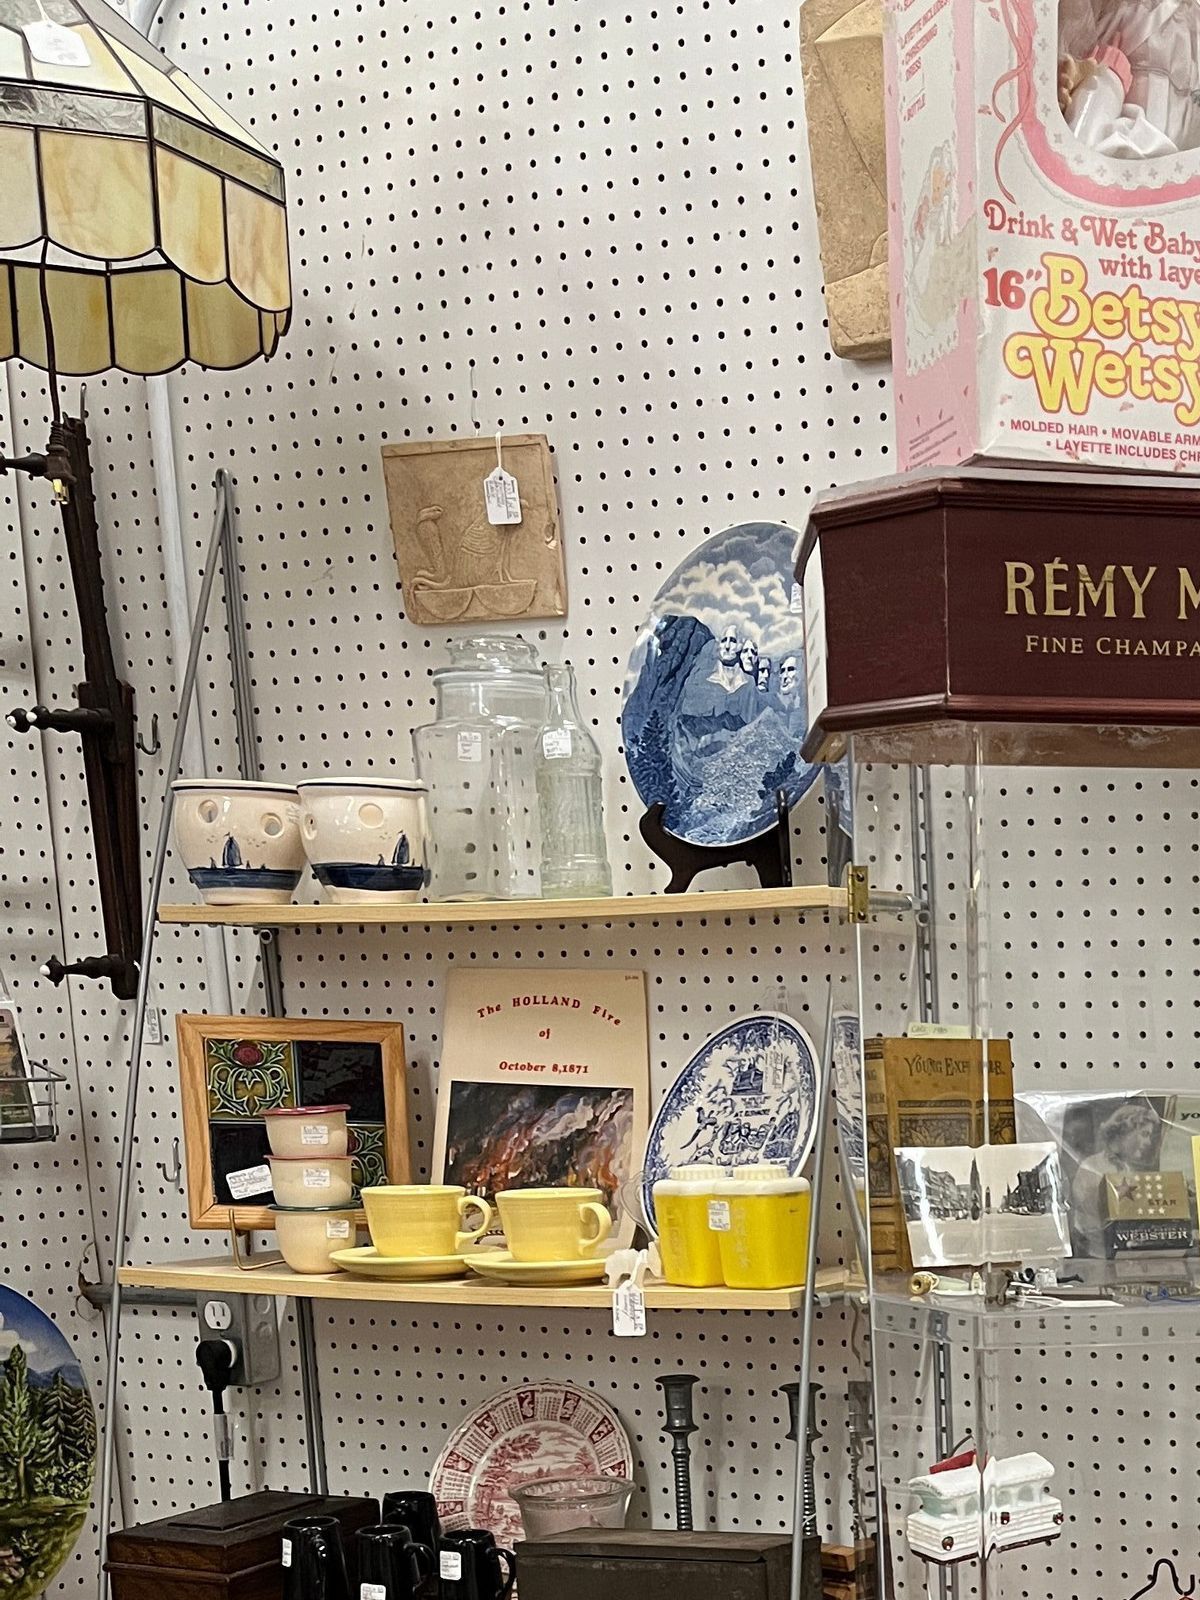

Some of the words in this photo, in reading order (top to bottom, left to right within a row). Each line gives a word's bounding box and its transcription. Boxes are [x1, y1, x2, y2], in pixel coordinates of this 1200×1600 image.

[983, 198, 1056, 240] Drink
[1060, 217, 1079, 246] &
[1079, 214, 1138, 250] Wet
[1098, 253, 1153, 281] with
[1009, 418, 1065, 434] MOLDED
[1067, 422, 1099, 437] HAIR
[1111, 427, 1172, 444] MOVABLE
[1055, 438, 1112, 455] LAYETTE
[1114, 442, 1177, 460] INCLUDES
[1004, 556, 1158, 620] RÉMY
[1025, 634, 1084, 655] FINE
[476, 1003, 502, 1019] The
[511, 995, 582, 1009] HOLLAND
[592, 1004, 622, 1027] Fire
[538, 1028, 551, 1040] of
[498, 1061, 547, 1073] October
[1116, 1231, 1189, 1242] WEBSTER
